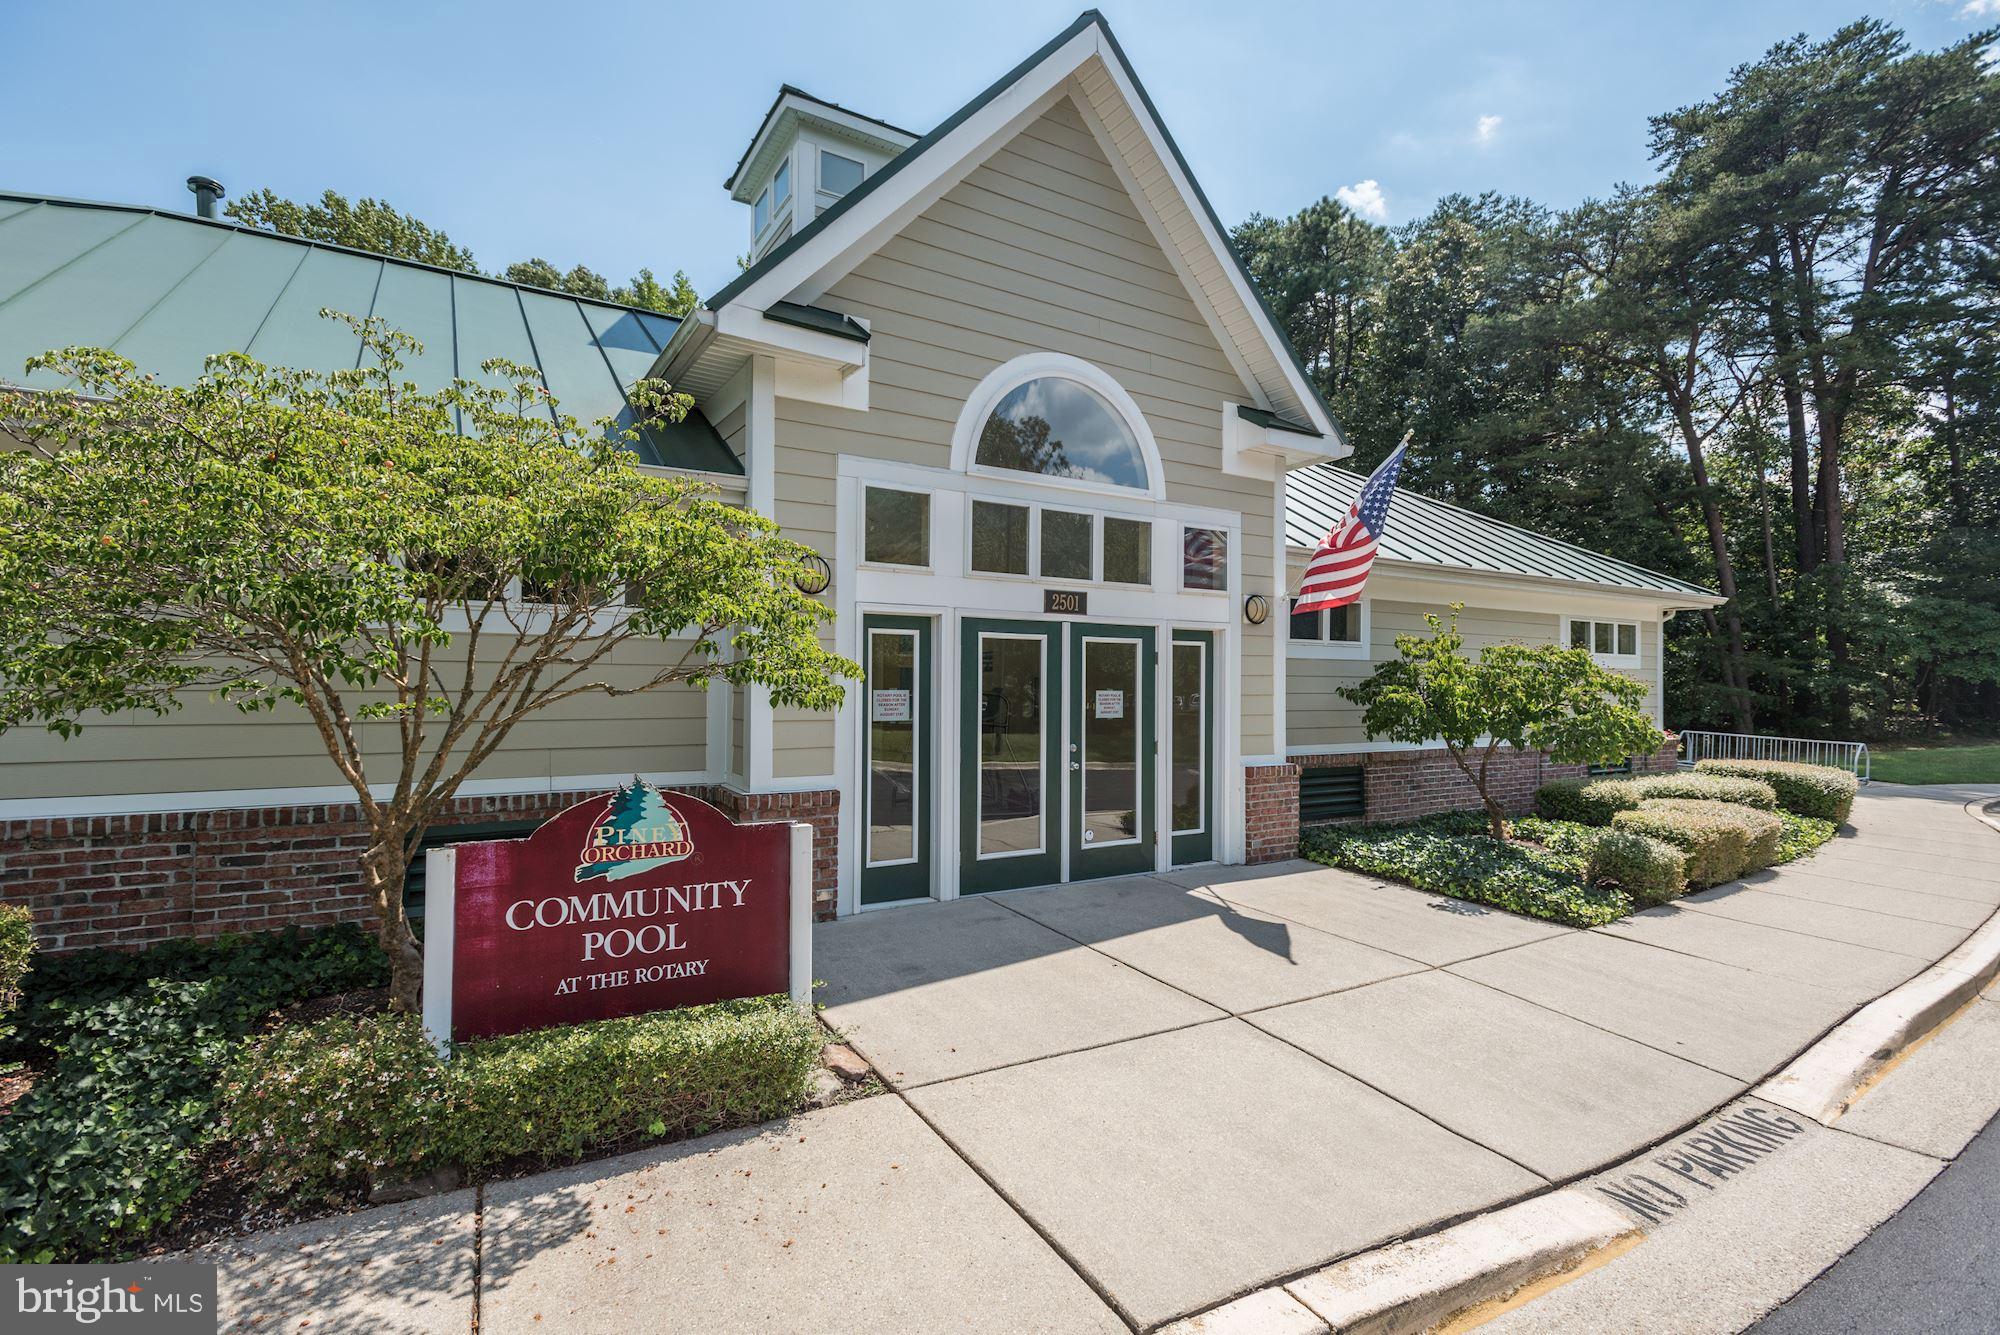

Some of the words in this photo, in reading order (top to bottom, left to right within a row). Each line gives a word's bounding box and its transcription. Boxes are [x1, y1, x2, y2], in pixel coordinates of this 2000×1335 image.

[1052, 593, 1079, 611] 2501
[585, 841, 691, 863] ORCHARD
[593, 821, 686, 846] PINEY
[505, 879, 751, 931] COMMUNITY
[581, 923, 687, 961] POOL
[554, 976, 582, 996] AT
[587, 970, 629, 990] THE
[634, 959, 710, 984] ROTARY
[1595, 1174, 1688, 1224] NO
[1653, 1107, 1805, 1190] PARKING
